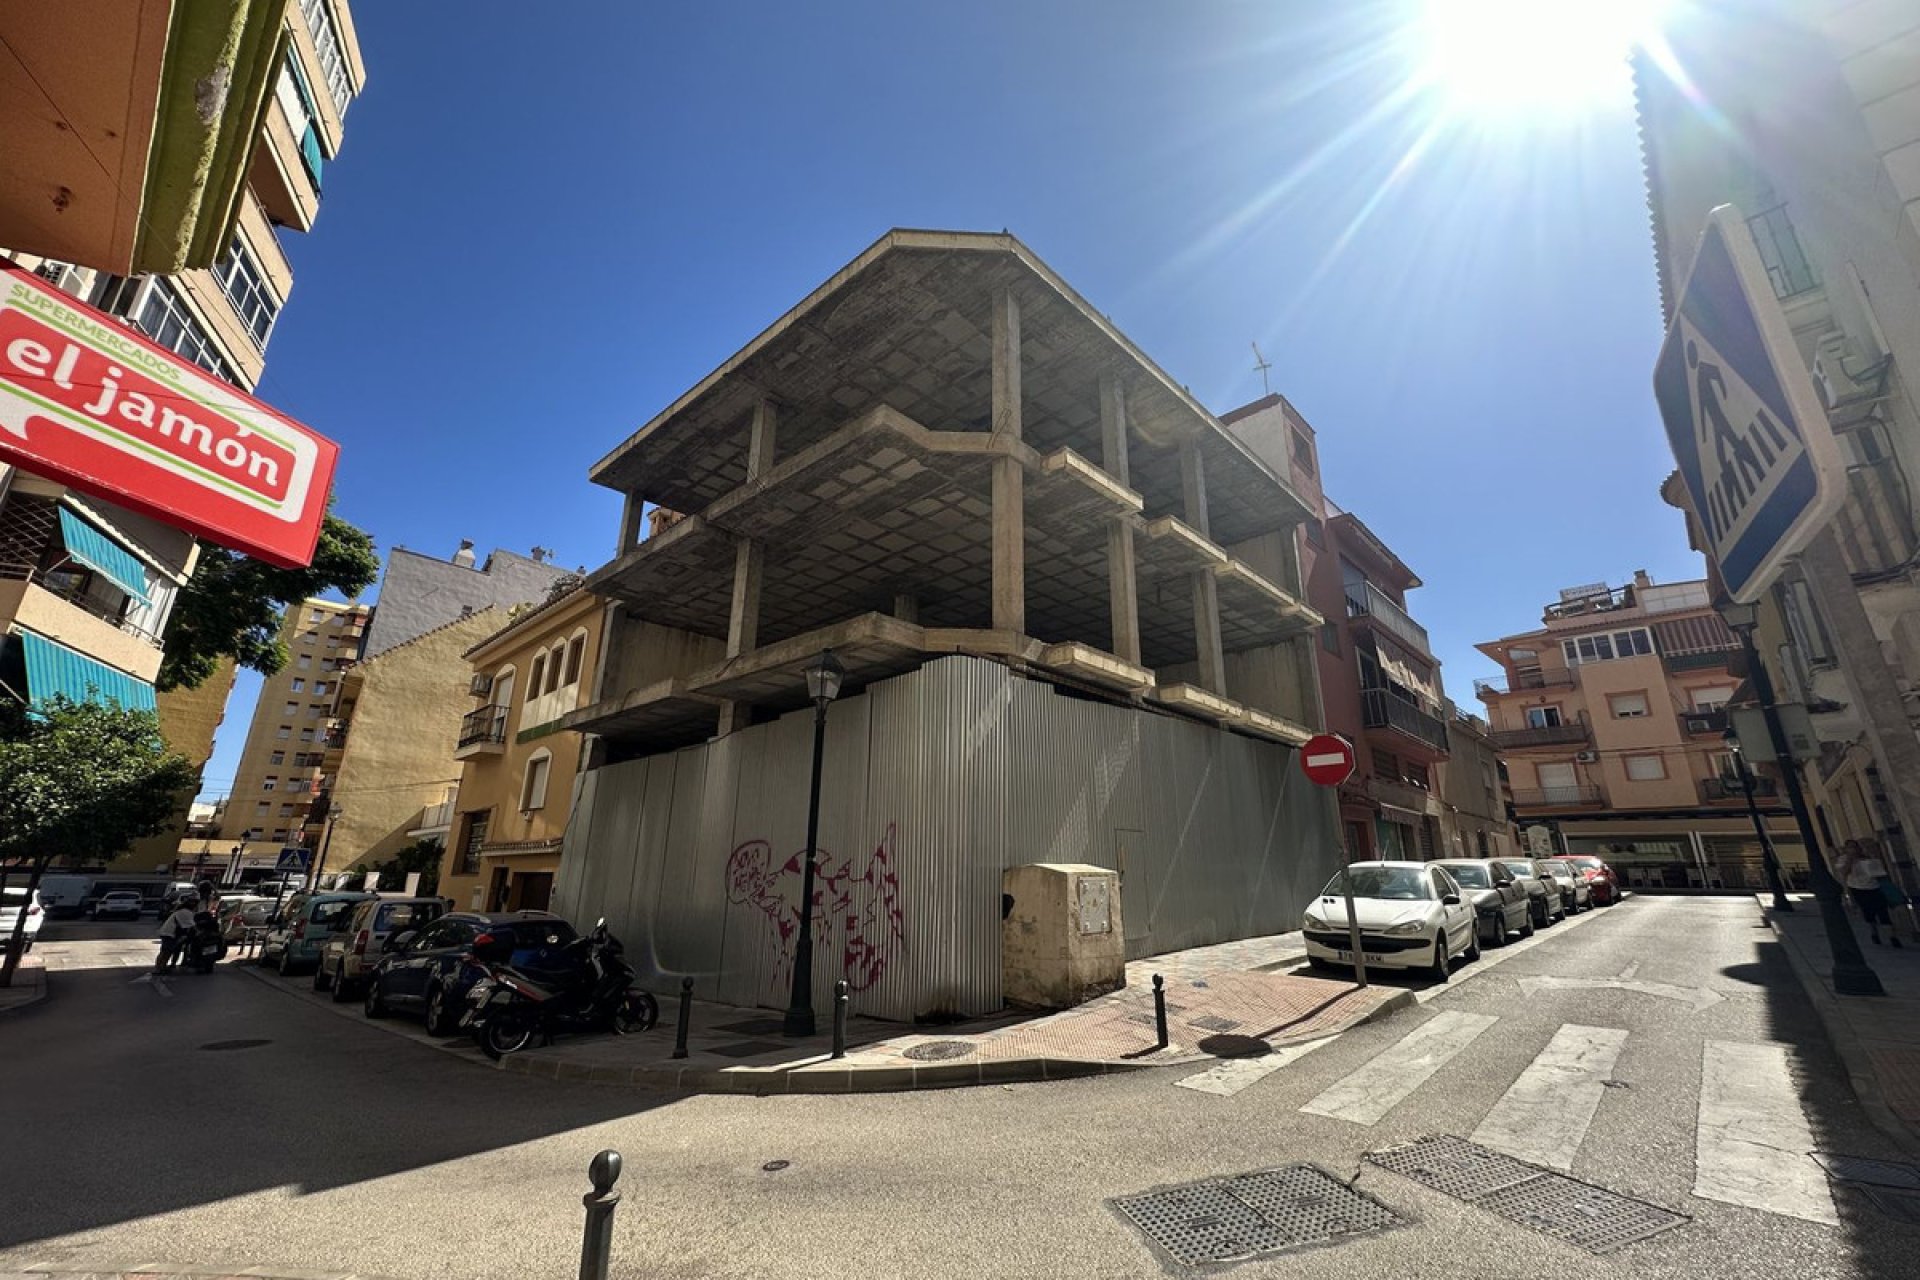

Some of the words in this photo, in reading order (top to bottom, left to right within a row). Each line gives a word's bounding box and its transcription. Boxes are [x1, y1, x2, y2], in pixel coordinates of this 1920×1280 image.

[10, 283, 182, 381] SUPERMERCADOS
[7, 338, 81, 390] el
[83, 366, 279, 486] jamón
